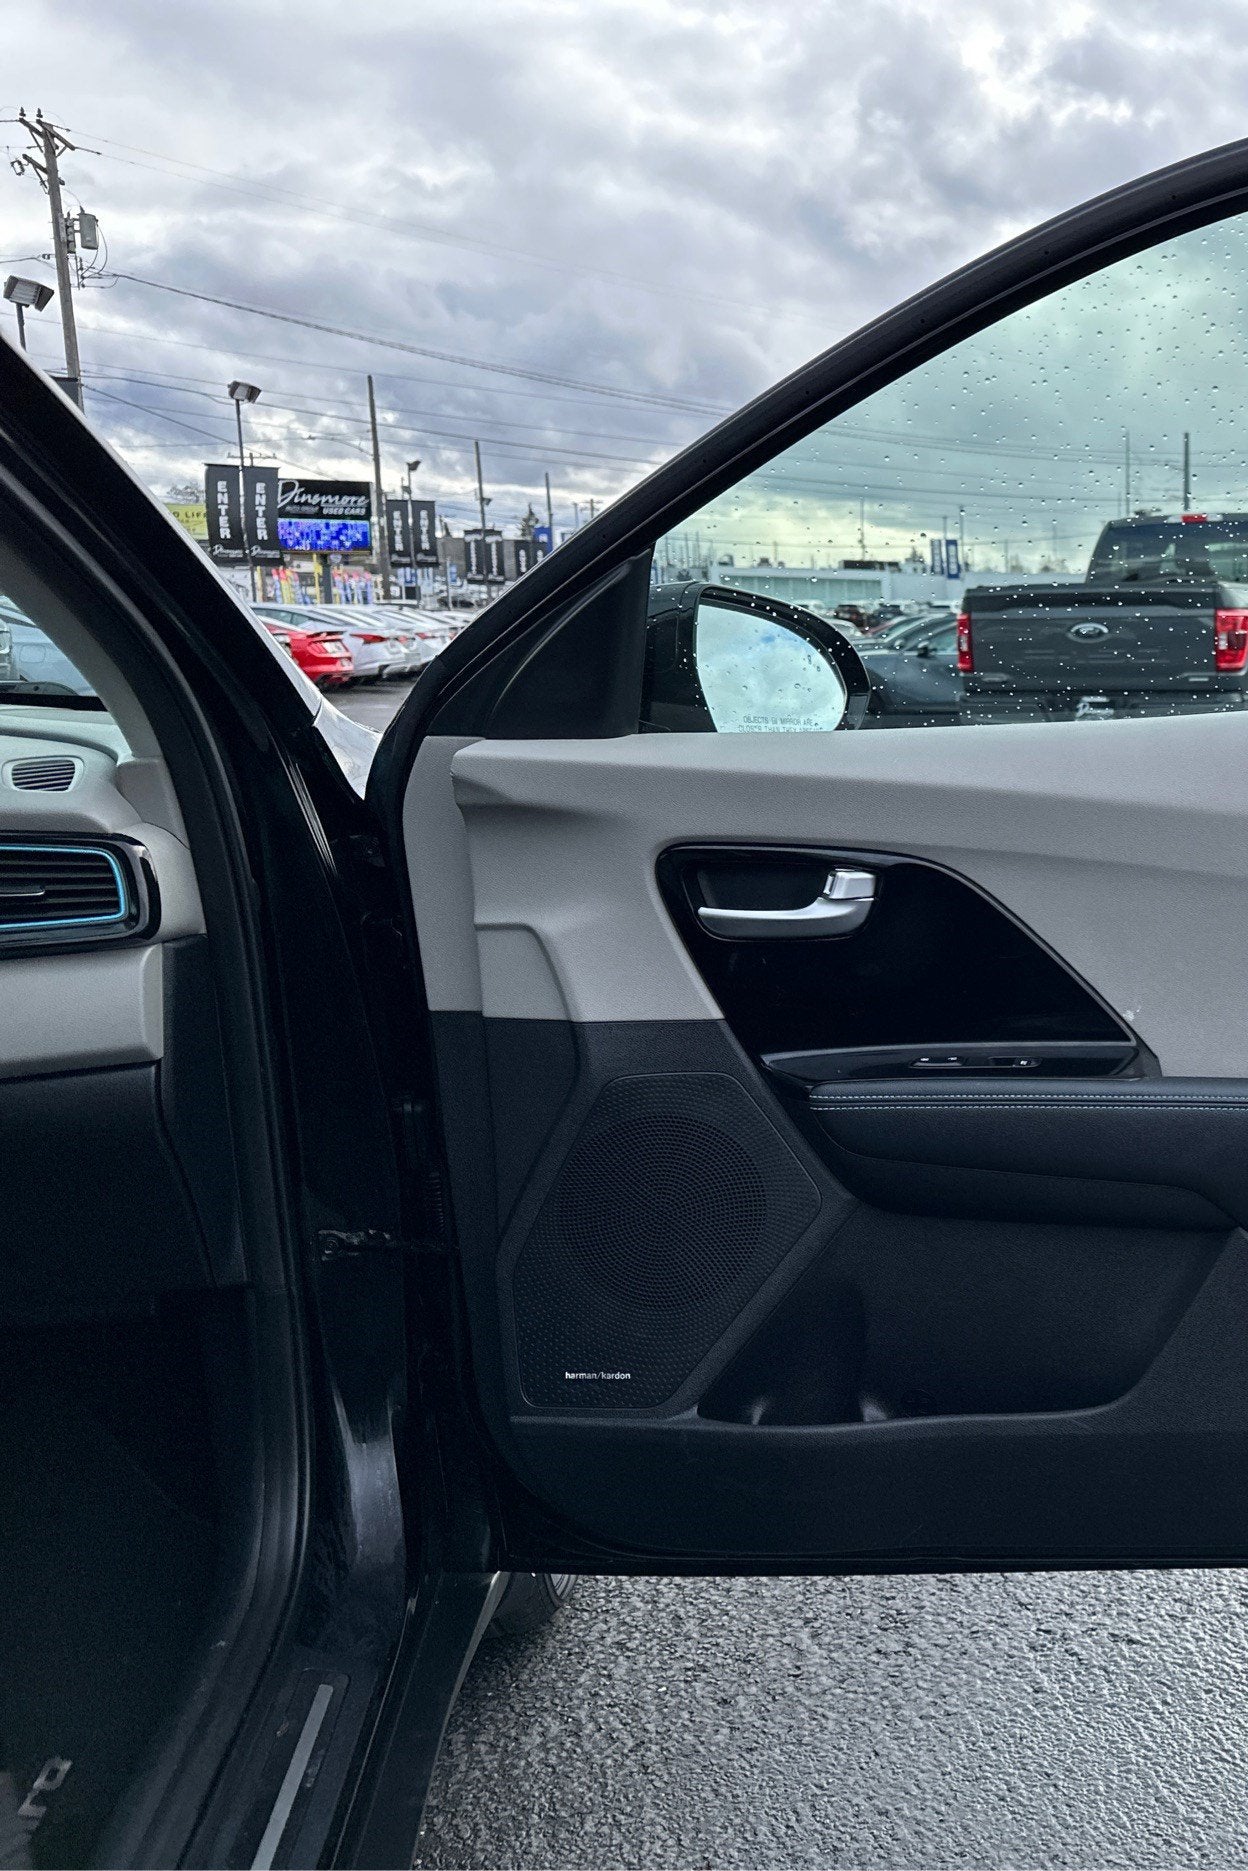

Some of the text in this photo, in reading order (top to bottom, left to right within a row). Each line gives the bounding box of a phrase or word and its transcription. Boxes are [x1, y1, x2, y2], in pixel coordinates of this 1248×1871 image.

[217, 481, 231, 539] ENTER
[255, 482, 268, 541] ENTER
[743, 716, 769, 724] OBJECTS
[780, 717, 802, 726] MIRROR
[565, 1371, 631, 1380] harman/kardon
